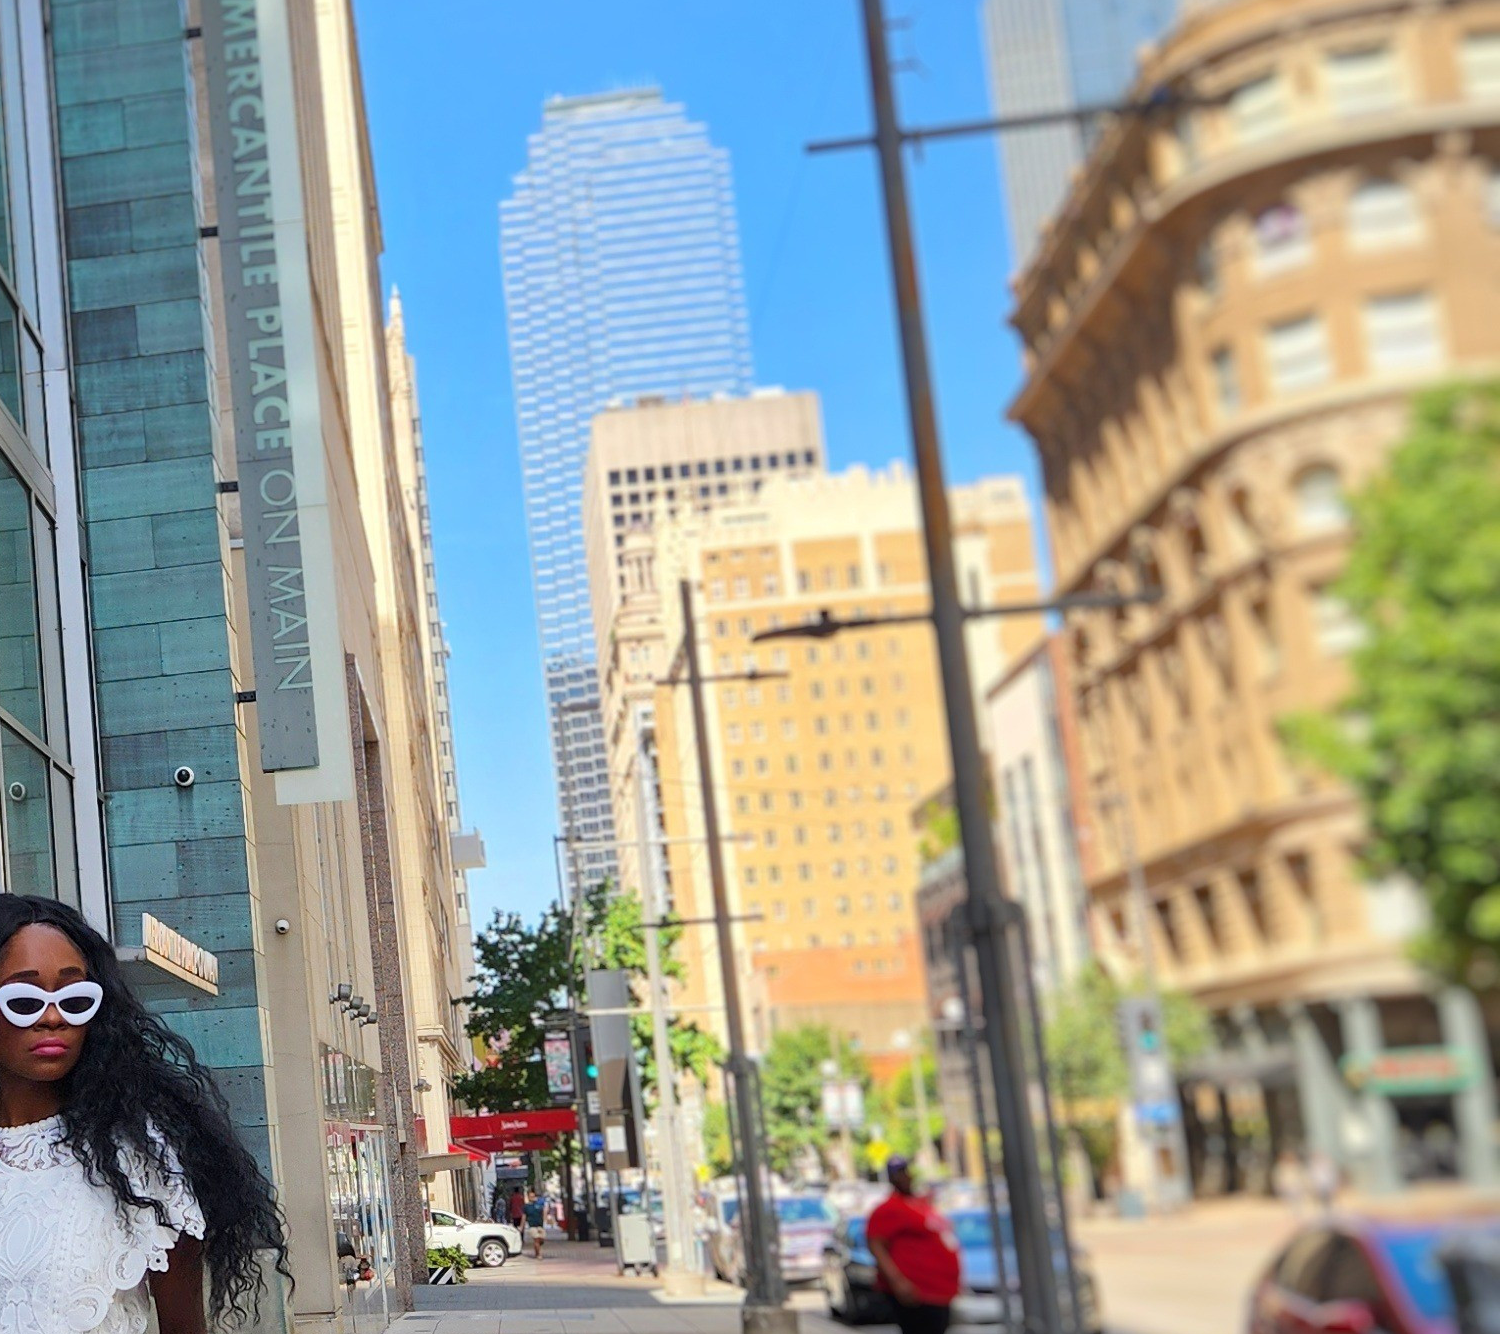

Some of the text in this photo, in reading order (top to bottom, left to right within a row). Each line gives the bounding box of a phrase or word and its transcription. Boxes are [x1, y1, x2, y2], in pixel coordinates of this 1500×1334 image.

[245, 307, 292, 451] PLACE
[259, 469, 300, 545] ON
[267, 566, 313, 692] MAIN
